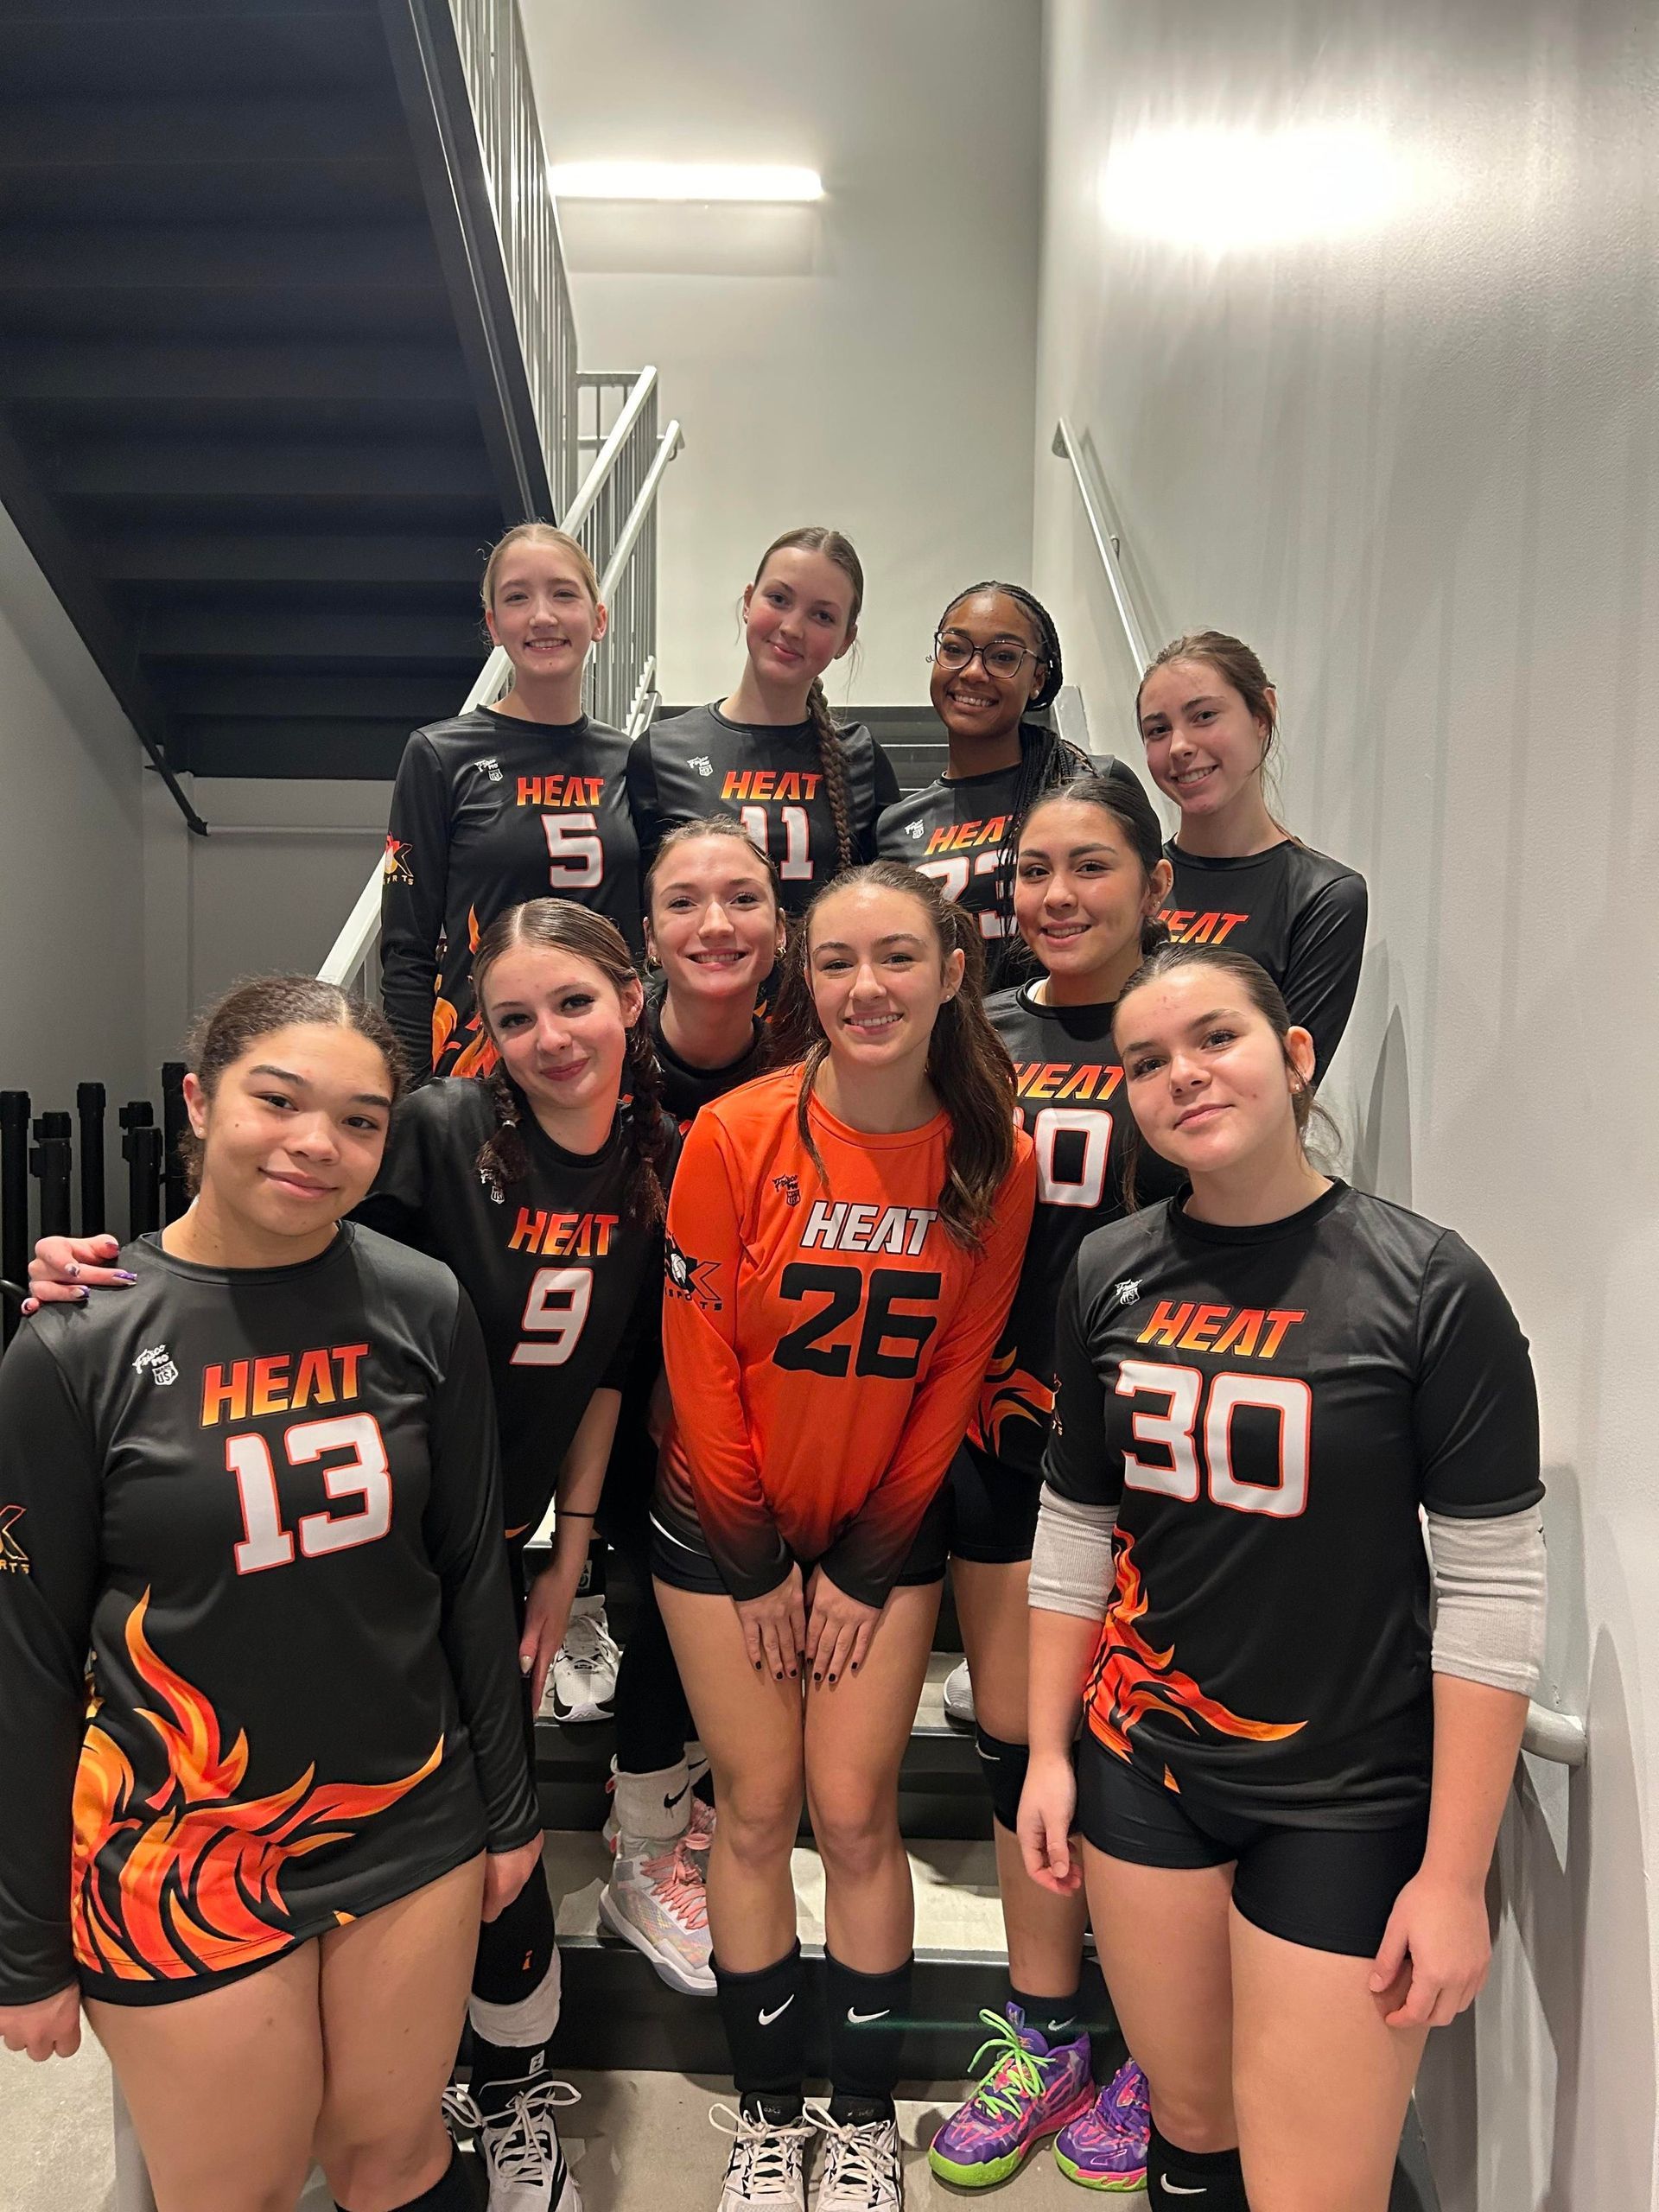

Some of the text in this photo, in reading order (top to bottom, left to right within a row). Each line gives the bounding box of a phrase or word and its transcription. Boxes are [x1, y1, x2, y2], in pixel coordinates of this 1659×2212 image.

[517, 776, 604, 807] HEAT
[720, 771, 823, 801] HEAT
[541, 813, 604, 888] 5
[741, 805, 814, 880] 11
[924, 815, 1013, 855] HEA
[1158, 909, 1249, 945] EAT
[1013, 1106, 1114, 1208] 0
[508, 1207, 620, 1256] HEAT
[800, 1201, 938, 1255] HEAT
[509, 1267, 594, 1366] 9
[772, 1262, 943, 1378] 26
[1136, 1300, 1306, 1358] HEAT
[200, 1343, 370, 1427] HEAT
[1115, 1360, 1313, 1518] 30
[226, 1412, 393, 1576] 13
